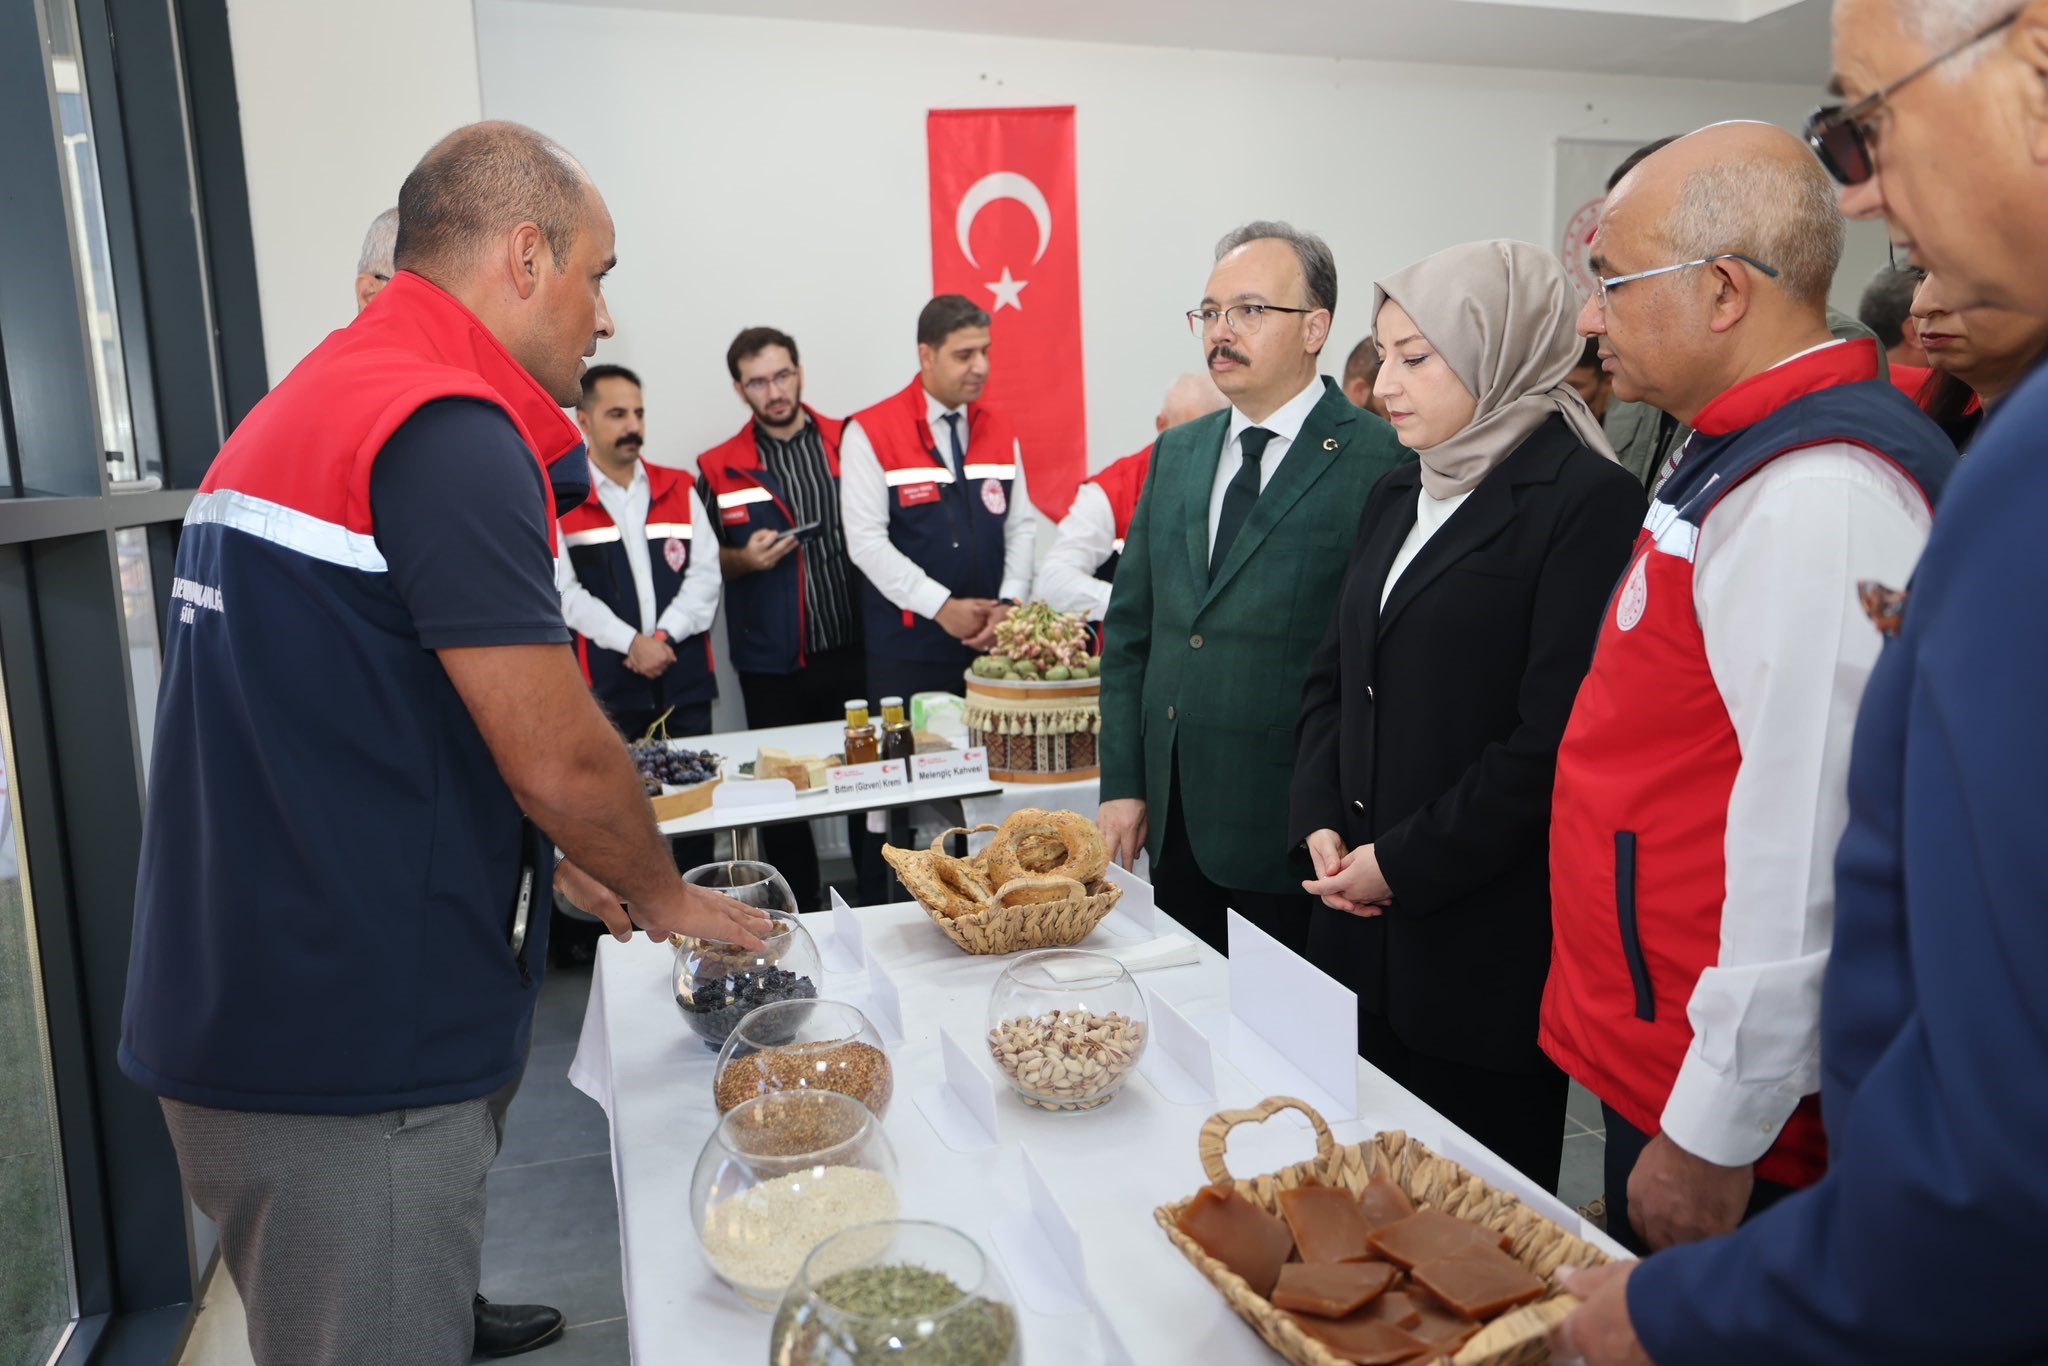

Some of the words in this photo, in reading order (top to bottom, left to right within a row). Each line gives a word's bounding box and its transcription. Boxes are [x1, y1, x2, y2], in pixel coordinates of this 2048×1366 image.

[919, 769, 952, 780] Melengiç
[953, 764, 982, 776] Kahvesi
[883, 778, 902, 788] Kremi
